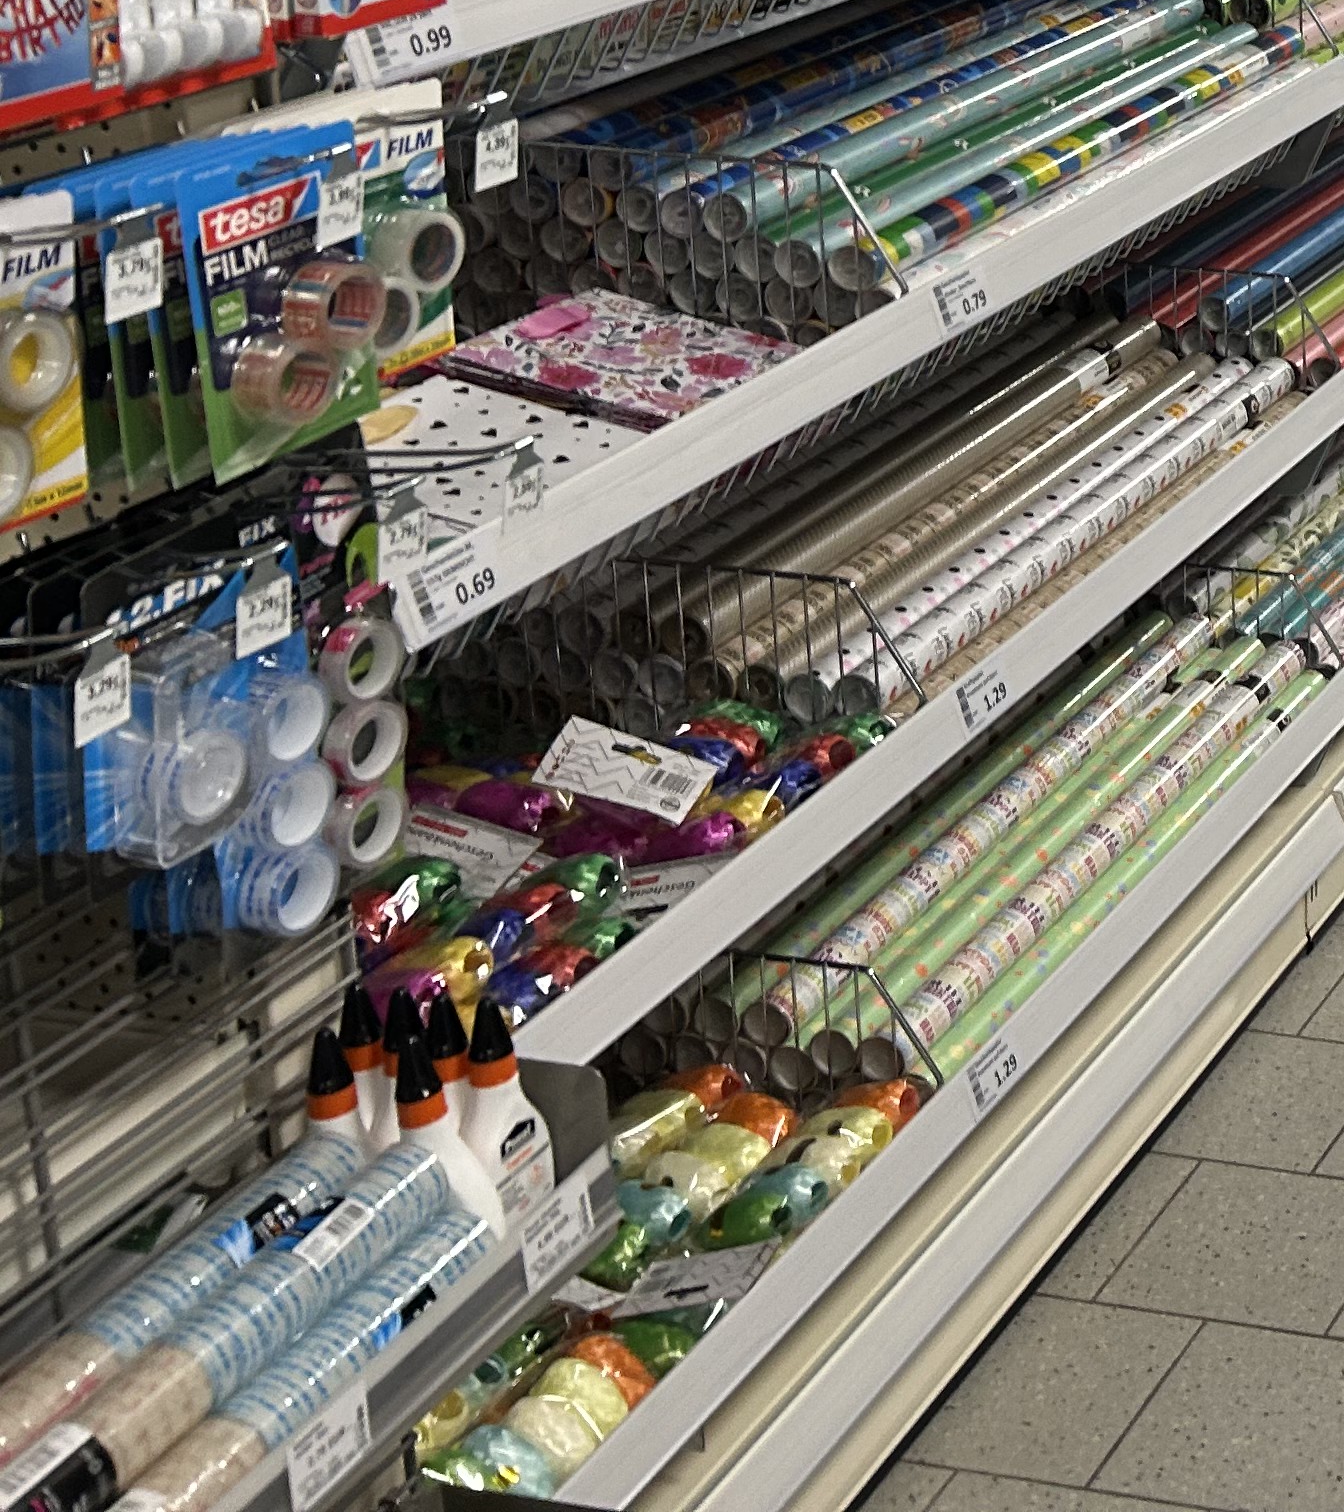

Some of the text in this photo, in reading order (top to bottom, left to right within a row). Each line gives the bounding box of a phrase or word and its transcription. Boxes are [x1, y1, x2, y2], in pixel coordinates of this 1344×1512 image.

[409, 24, 452, 57] 0.99
[386, 128, 434, 161] FILM
[209, 194, 287, 242] tesa
[2, 242, 62, 284] FILM
[203, 238, 271, 288] FILM
[962, 289, 987, 315] 0.79
[238, 515, 277, 548] FIX
[454, 567, 497, 606] 0.69
[983, 682, 1008, 713] 1.29
[994, 1053, 1018, 1088] 1.29
